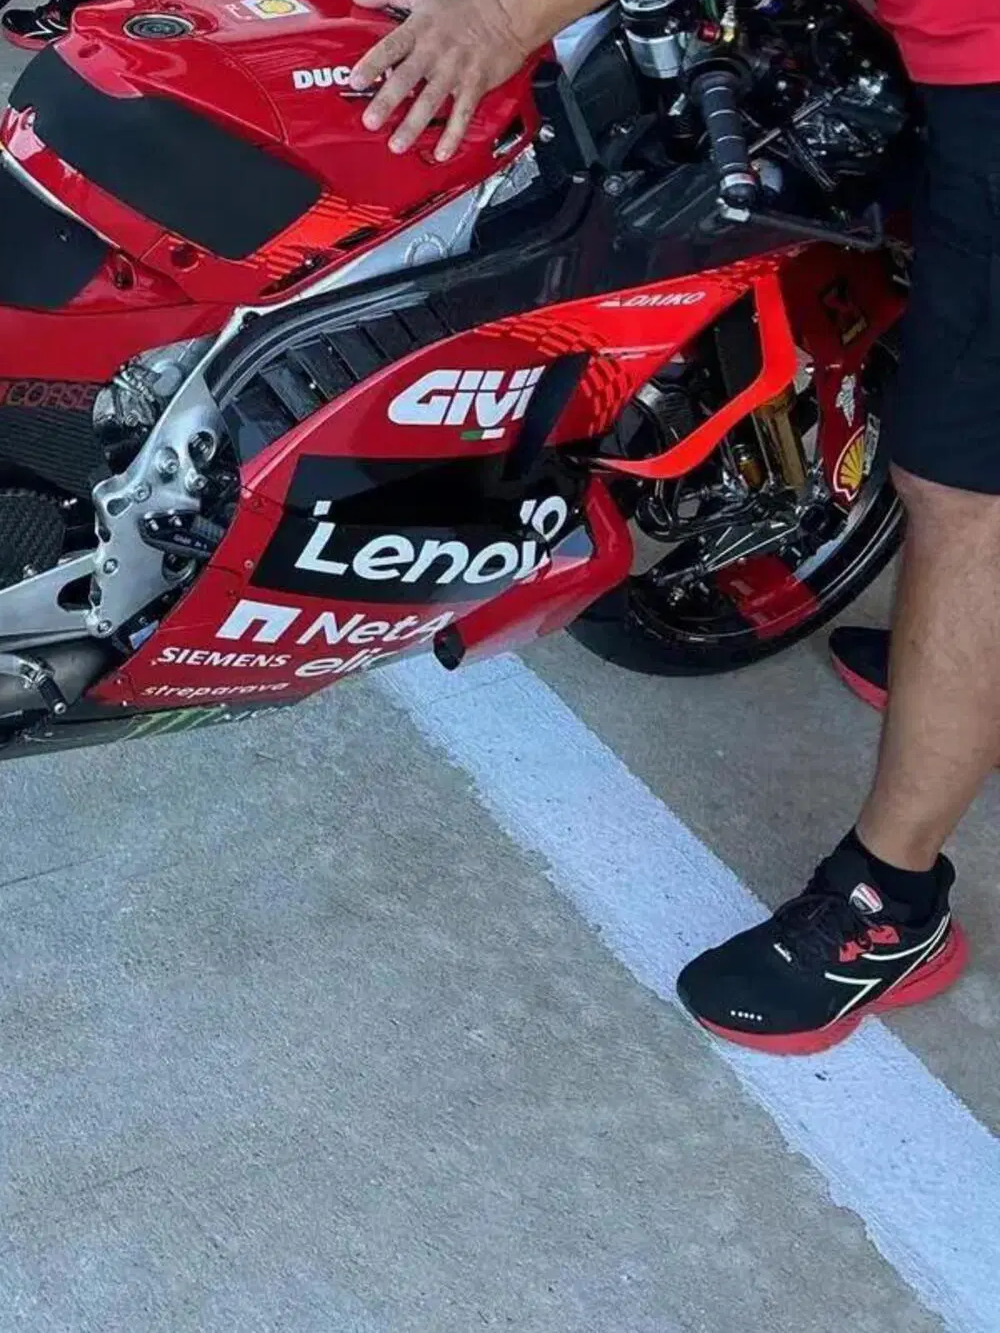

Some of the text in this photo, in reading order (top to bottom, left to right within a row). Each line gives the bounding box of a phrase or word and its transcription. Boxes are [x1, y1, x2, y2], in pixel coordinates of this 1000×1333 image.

[619, 291, 707, 307] DAIKO
[387, 365, 547, 429] GIVI
[295, 495, 568, 585] Lenovo
[296, 610, 454, 645] NetA
[157, 646, 292, 667] SIEMENS
